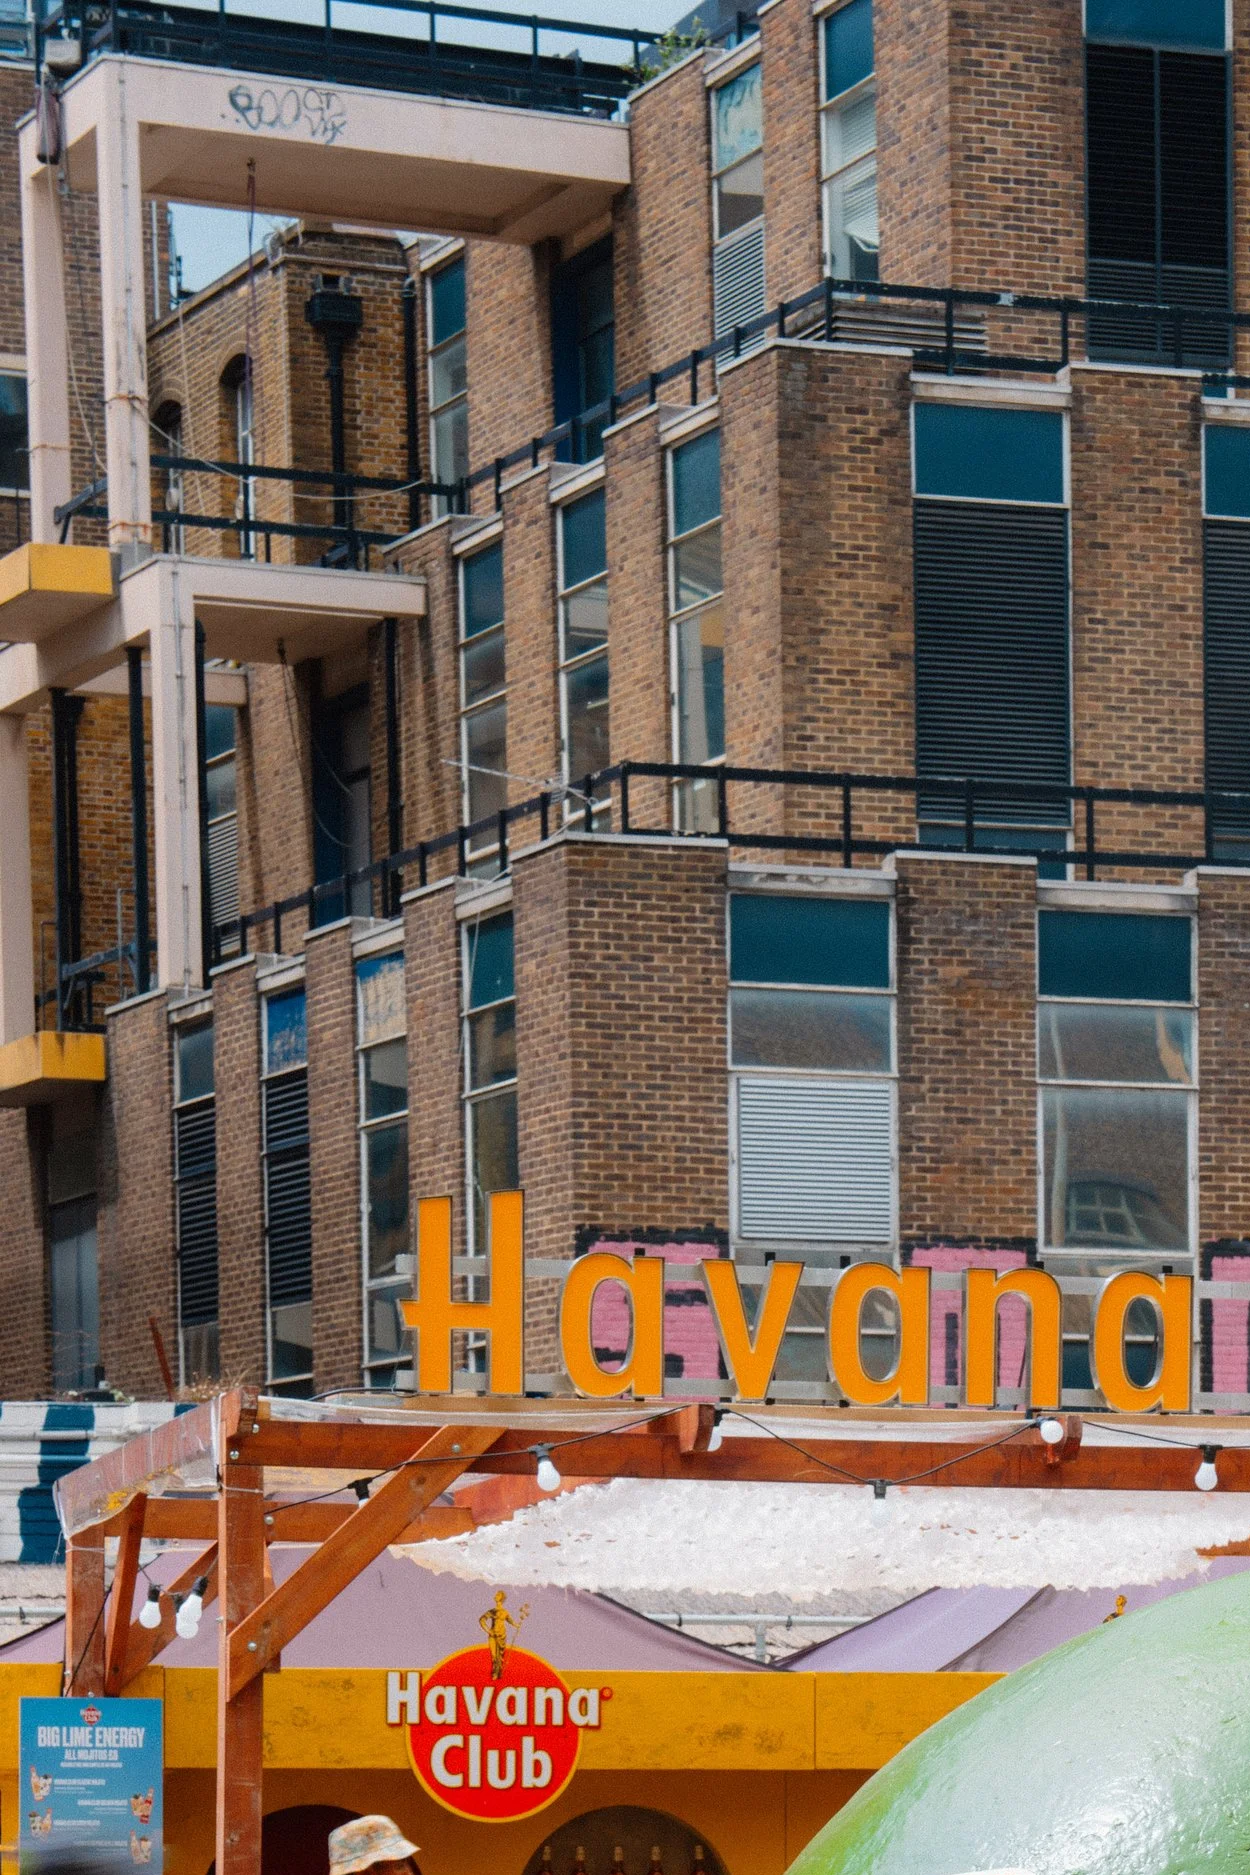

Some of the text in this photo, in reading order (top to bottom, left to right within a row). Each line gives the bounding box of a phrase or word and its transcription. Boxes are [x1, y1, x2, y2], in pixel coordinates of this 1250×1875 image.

[398, 1189, 1194, 1414] Havana
[385, 1671, 601, 1727] Havana
[37, 1726, 145, 1748] BIG LIME ENERGY
[430, 1734, 553, 1790] Club
